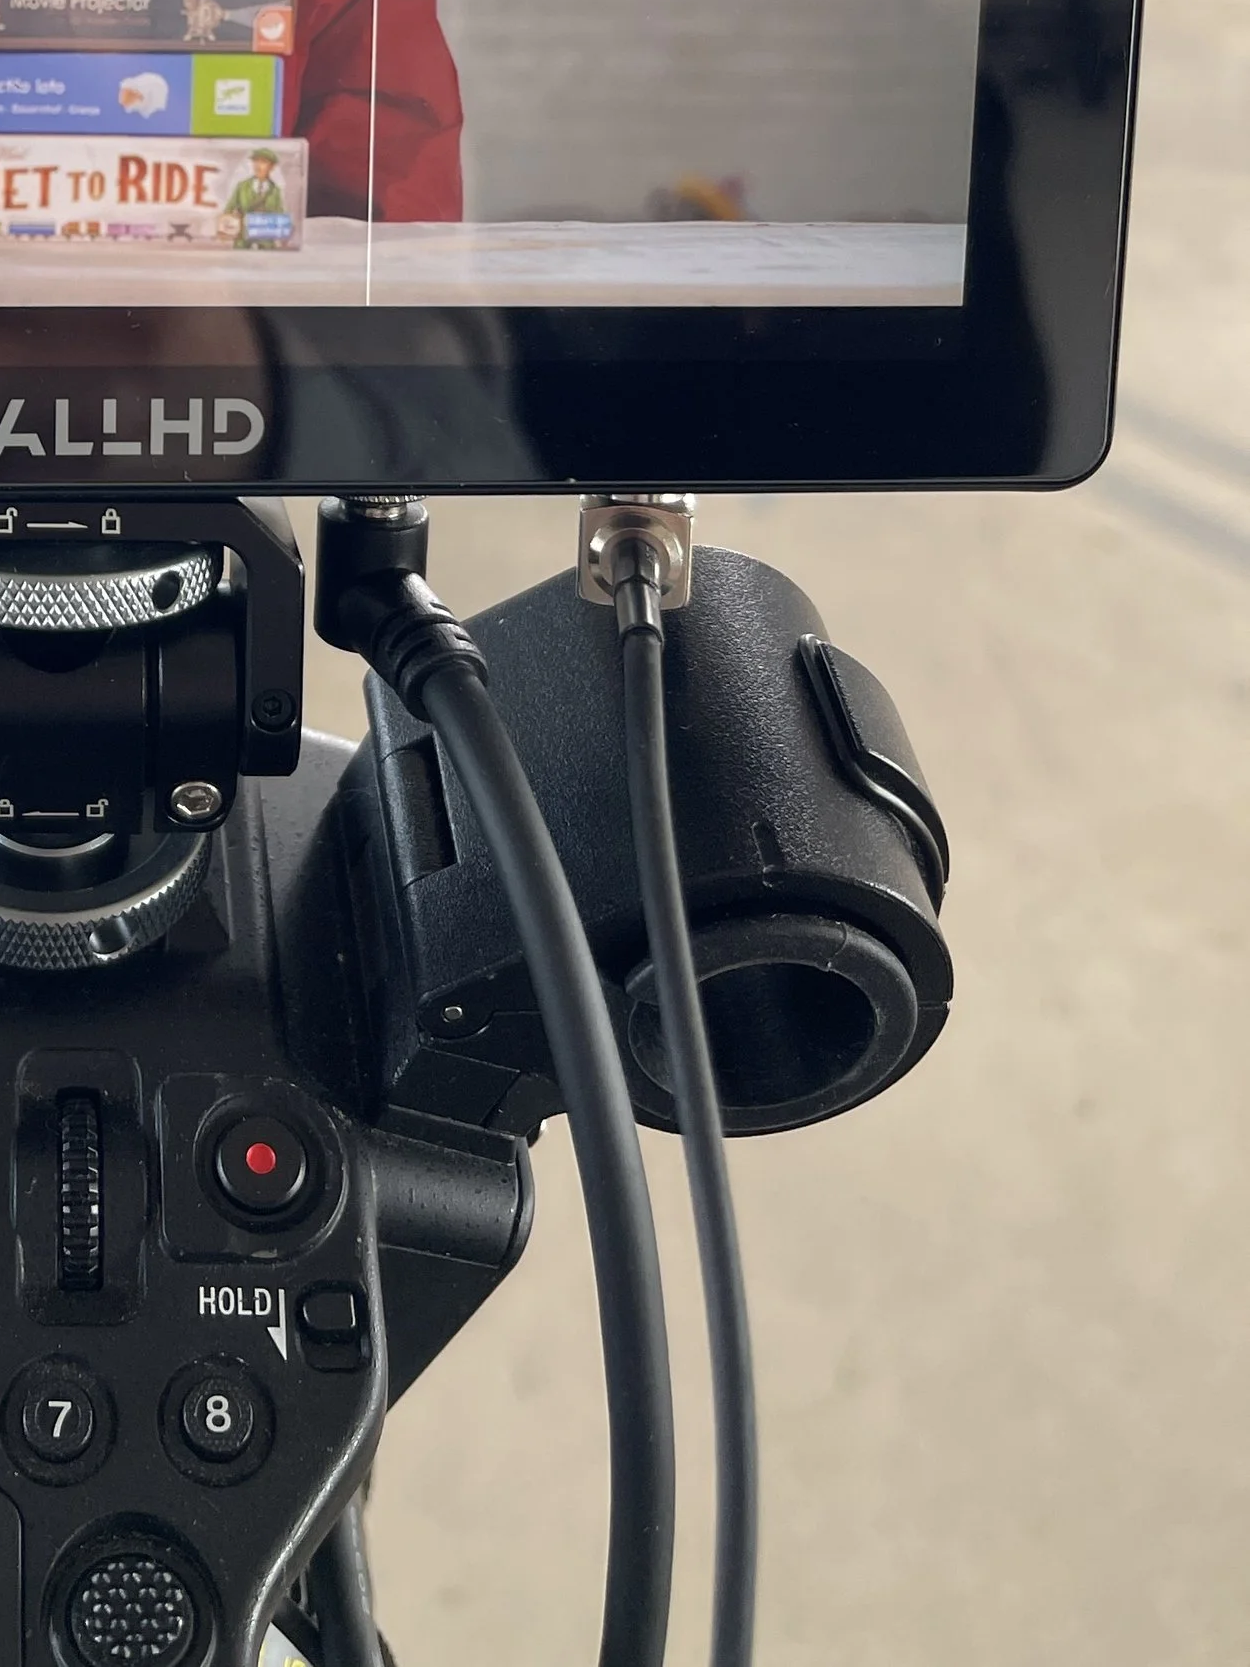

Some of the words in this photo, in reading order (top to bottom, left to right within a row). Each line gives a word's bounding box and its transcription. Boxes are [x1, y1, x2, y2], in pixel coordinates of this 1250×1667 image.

[66, 170, 106, 202] TO
[117, 154, 220, 208] RIDE
[199, 1286, 272, 1316] HOLD
[48, 1400, 72, 1438] 7
[205, 1394, 232, 1433] 8
